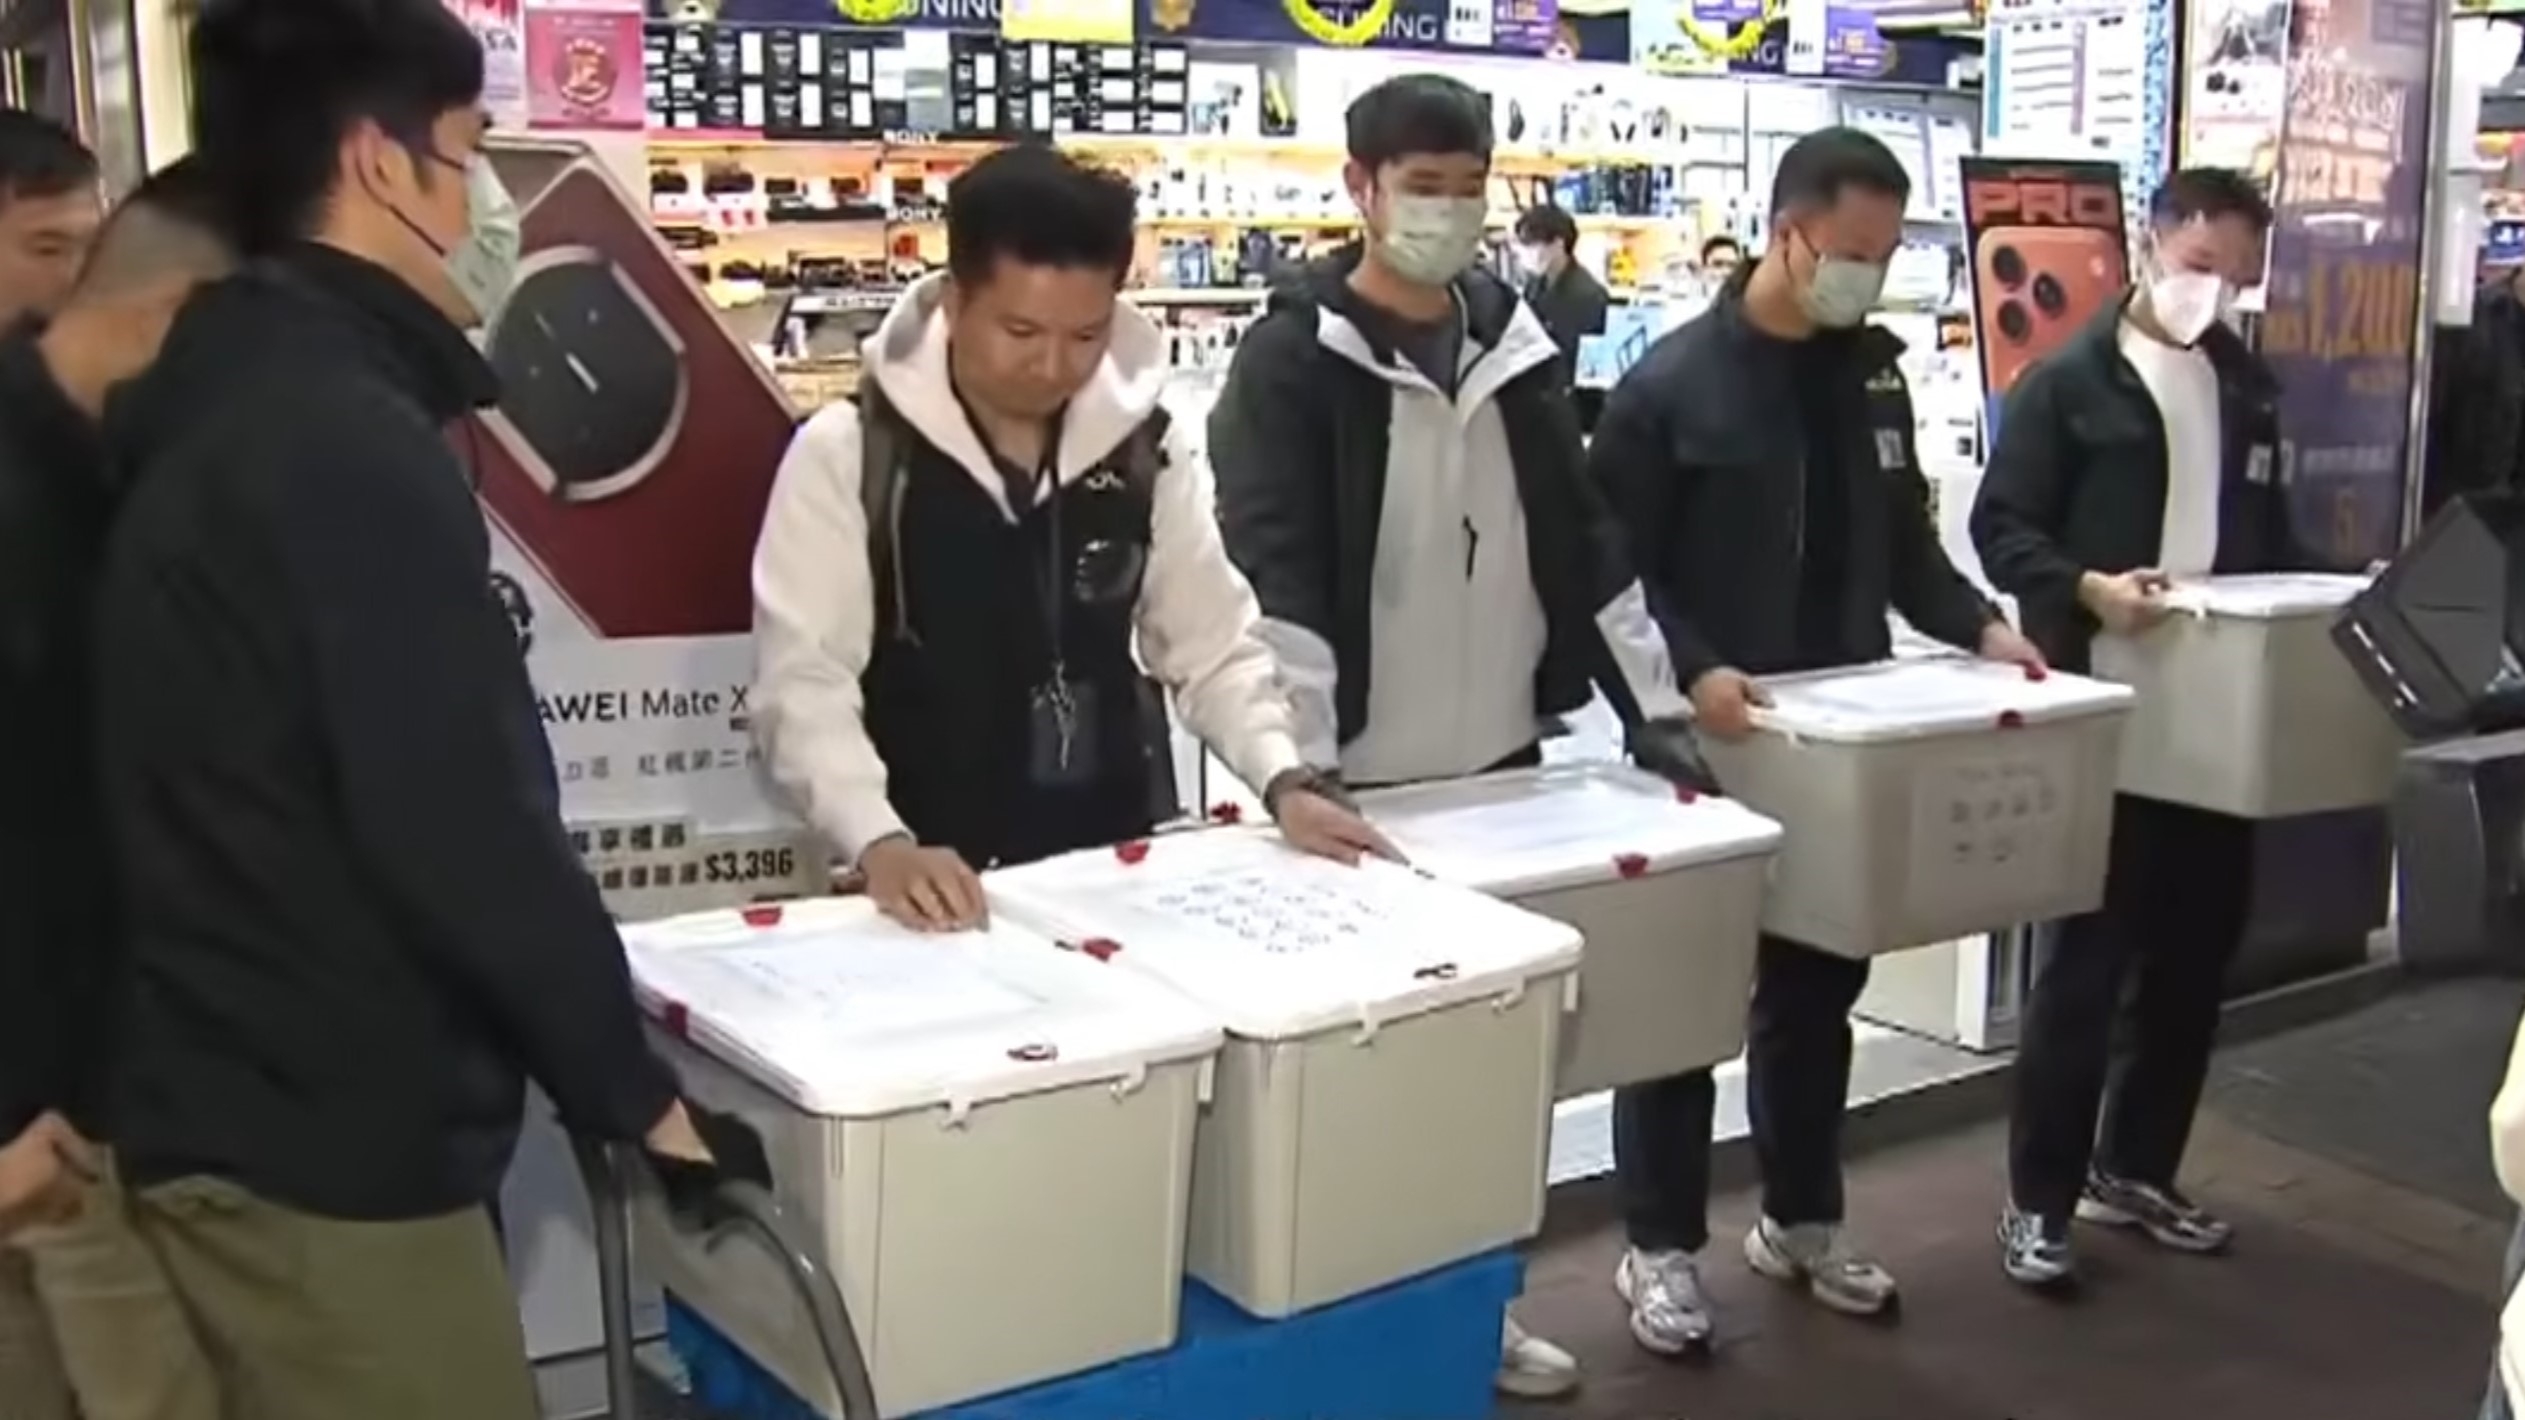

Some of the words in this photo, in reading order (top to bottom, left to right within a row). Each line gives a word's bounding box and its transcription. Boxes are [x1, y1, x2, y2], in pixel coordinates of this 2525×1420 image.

[1968, 181, 2119, 225] PRO
[642, 688, 720, 718] Mate
[704, 848, 794, 883] $3,396
